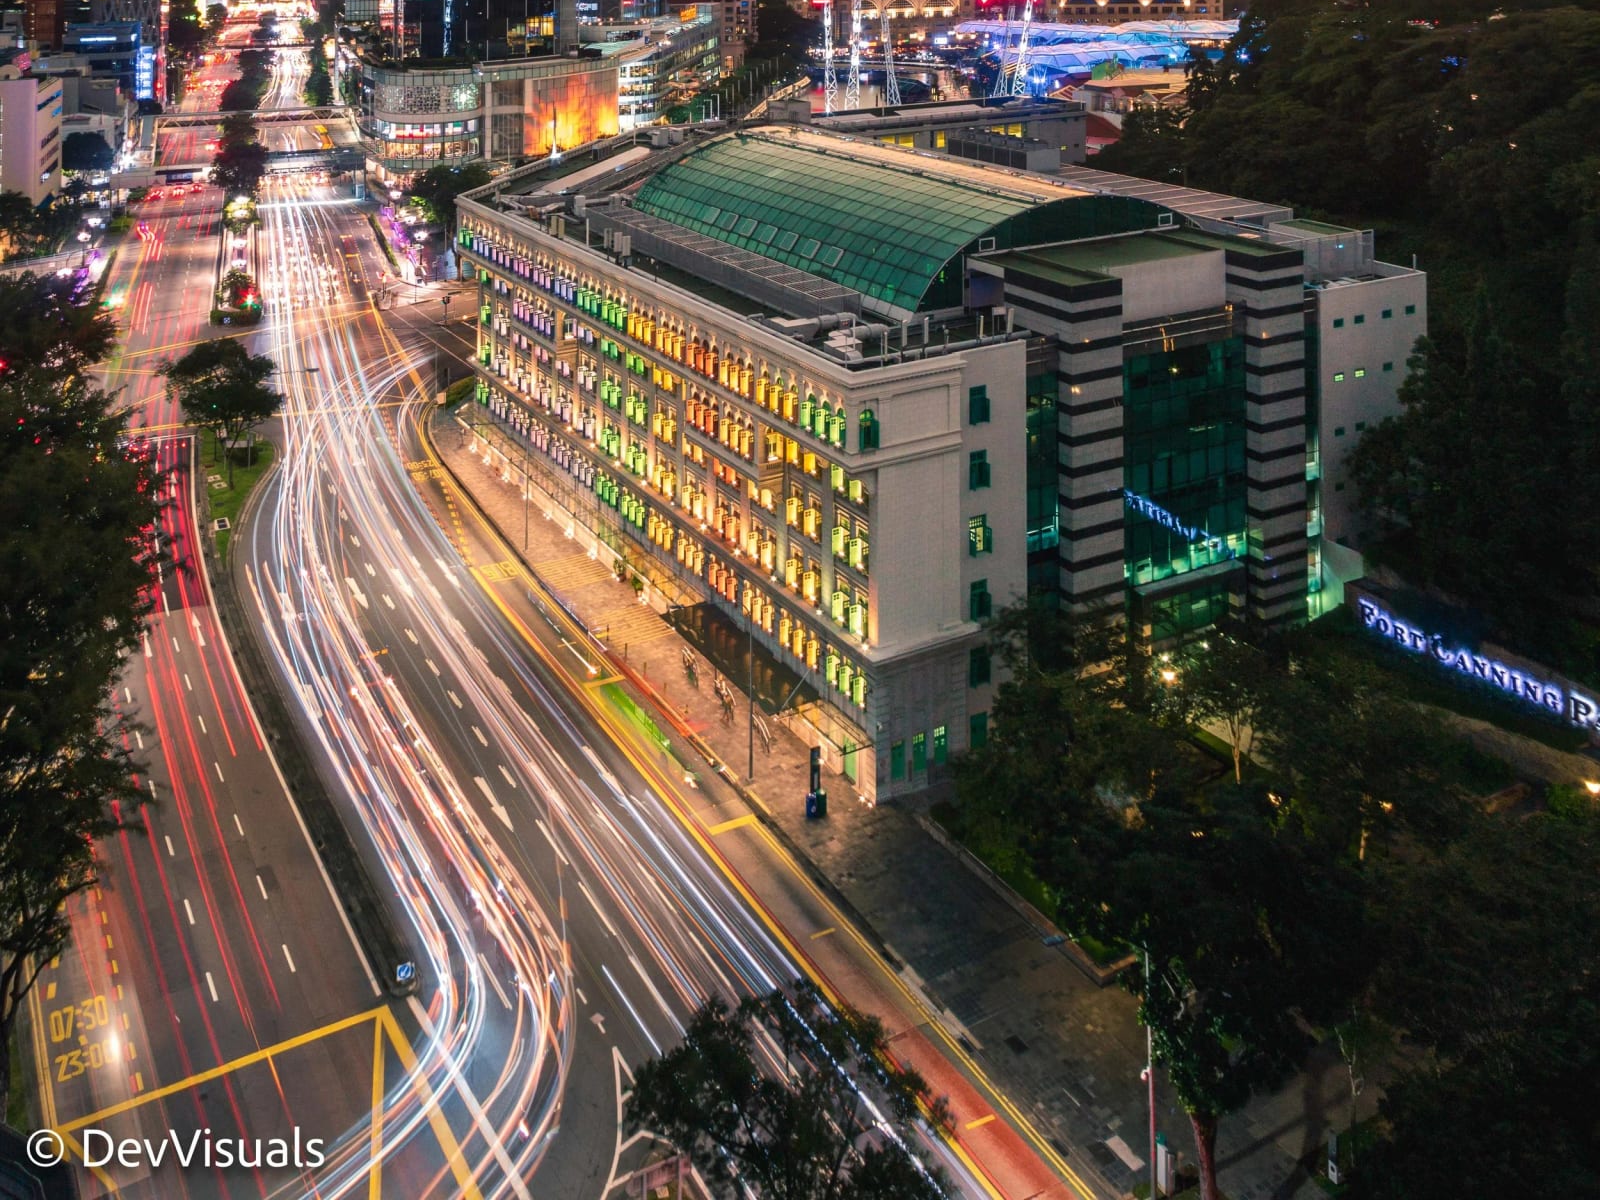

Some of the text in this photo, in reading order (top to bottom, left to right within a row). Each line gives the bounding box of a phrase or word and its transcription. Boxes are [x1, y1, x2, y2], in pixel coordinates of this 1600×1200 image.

[1358, 599, 1427, 652] FORT
[1431, 635, 1562, 712] CANNING
[49, 995, 109, 1043] 07:30
